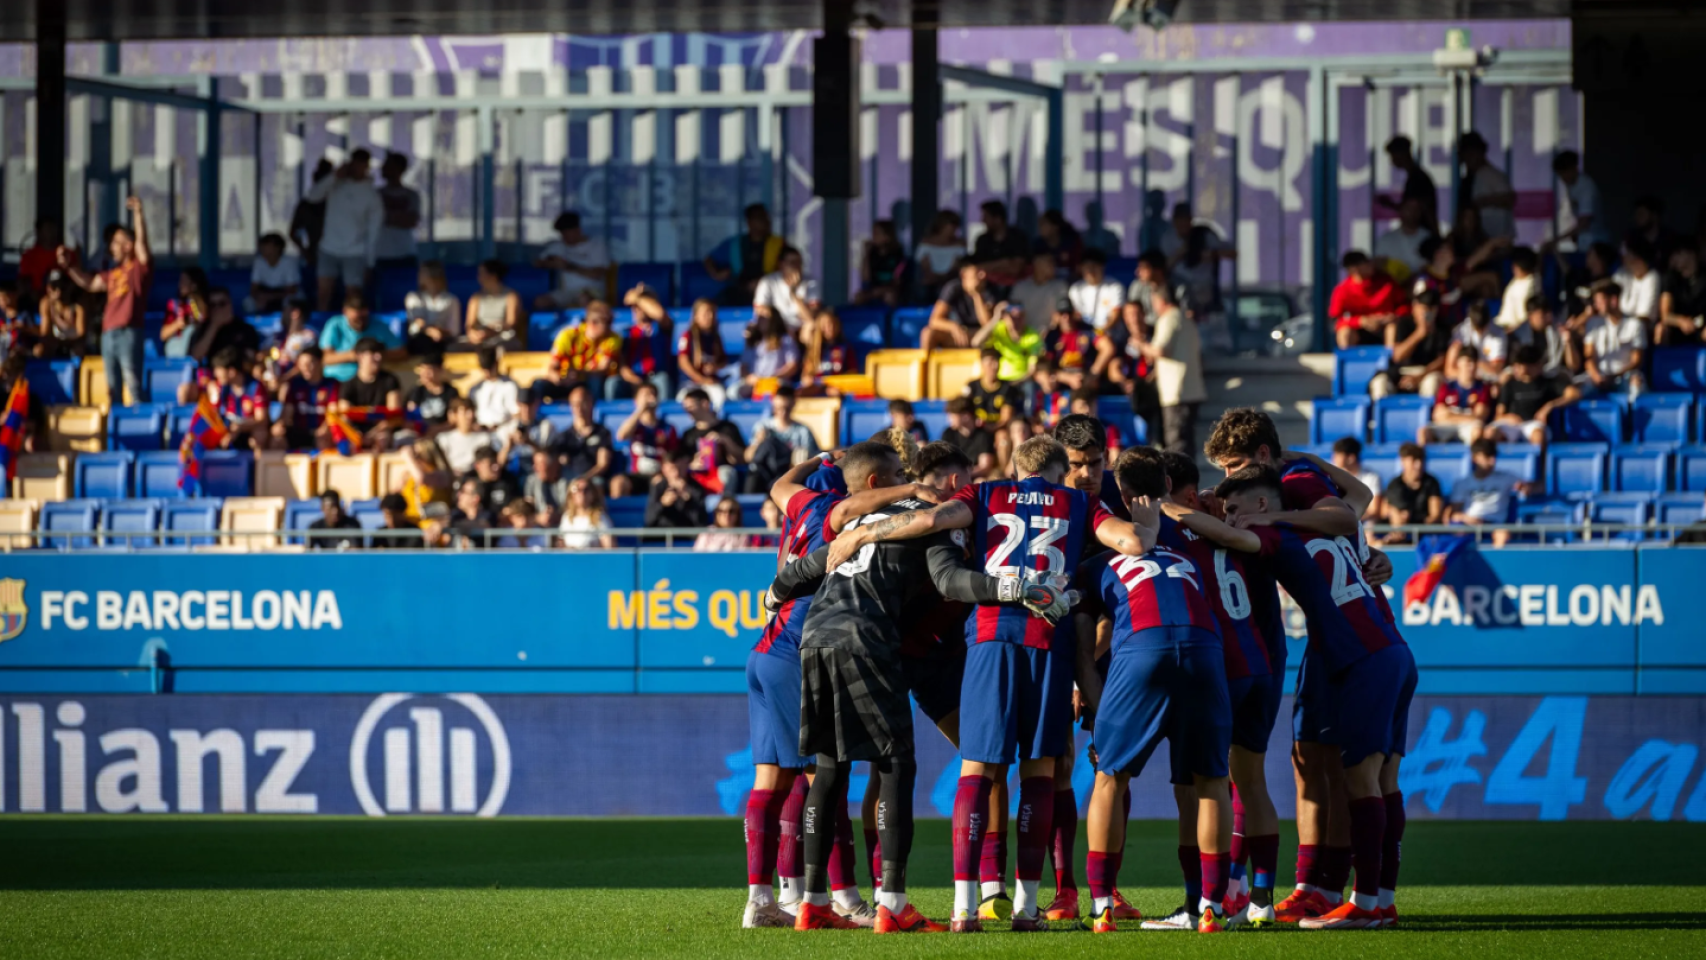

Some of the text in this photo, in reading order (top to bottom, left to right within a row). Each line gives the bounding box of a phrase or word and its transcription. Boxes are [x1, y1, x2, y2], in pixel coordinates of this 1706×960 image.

[985, 512, 1070, 580] 23
[41, 589, 343, 631] FC BARCELONA
[608, 579, 768, 638] MÉS QU
[1214, 549, 1252, 620] 6
[1403, 583, 1665, 627] BARCELONA
[0, 700, 319, 813] lianz
[1398, 695, 1706, 822] #4a
[805, 806, 817, 834] BARÇA
[968, 813, 981, 842] BARÇA
[1019, 803, 1032, 834] BARÇA
